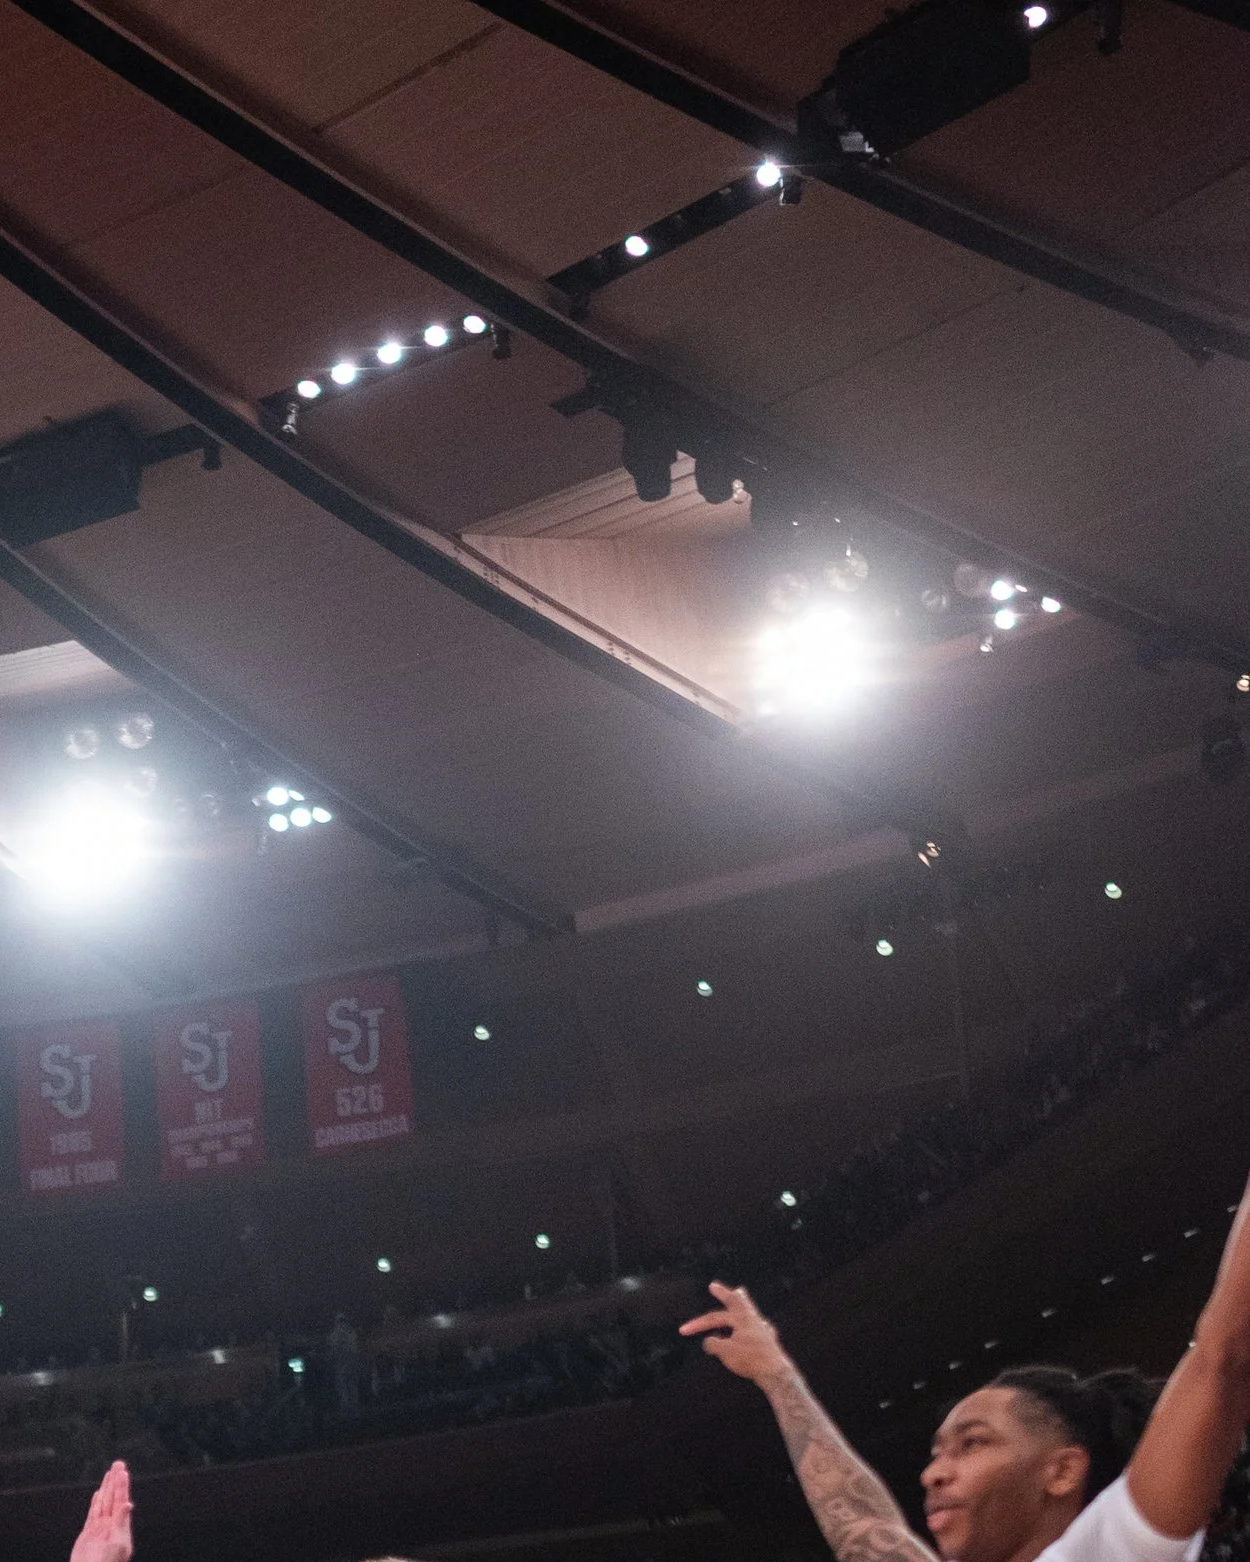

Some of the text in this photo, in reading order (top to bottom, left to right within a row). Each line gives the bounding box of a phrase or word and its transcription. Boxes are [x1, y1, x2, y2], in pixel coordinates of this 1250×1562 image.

[335, 1084, 384, 1117] 526
[30, 1159, 118, 1191] FINAL FOUR
